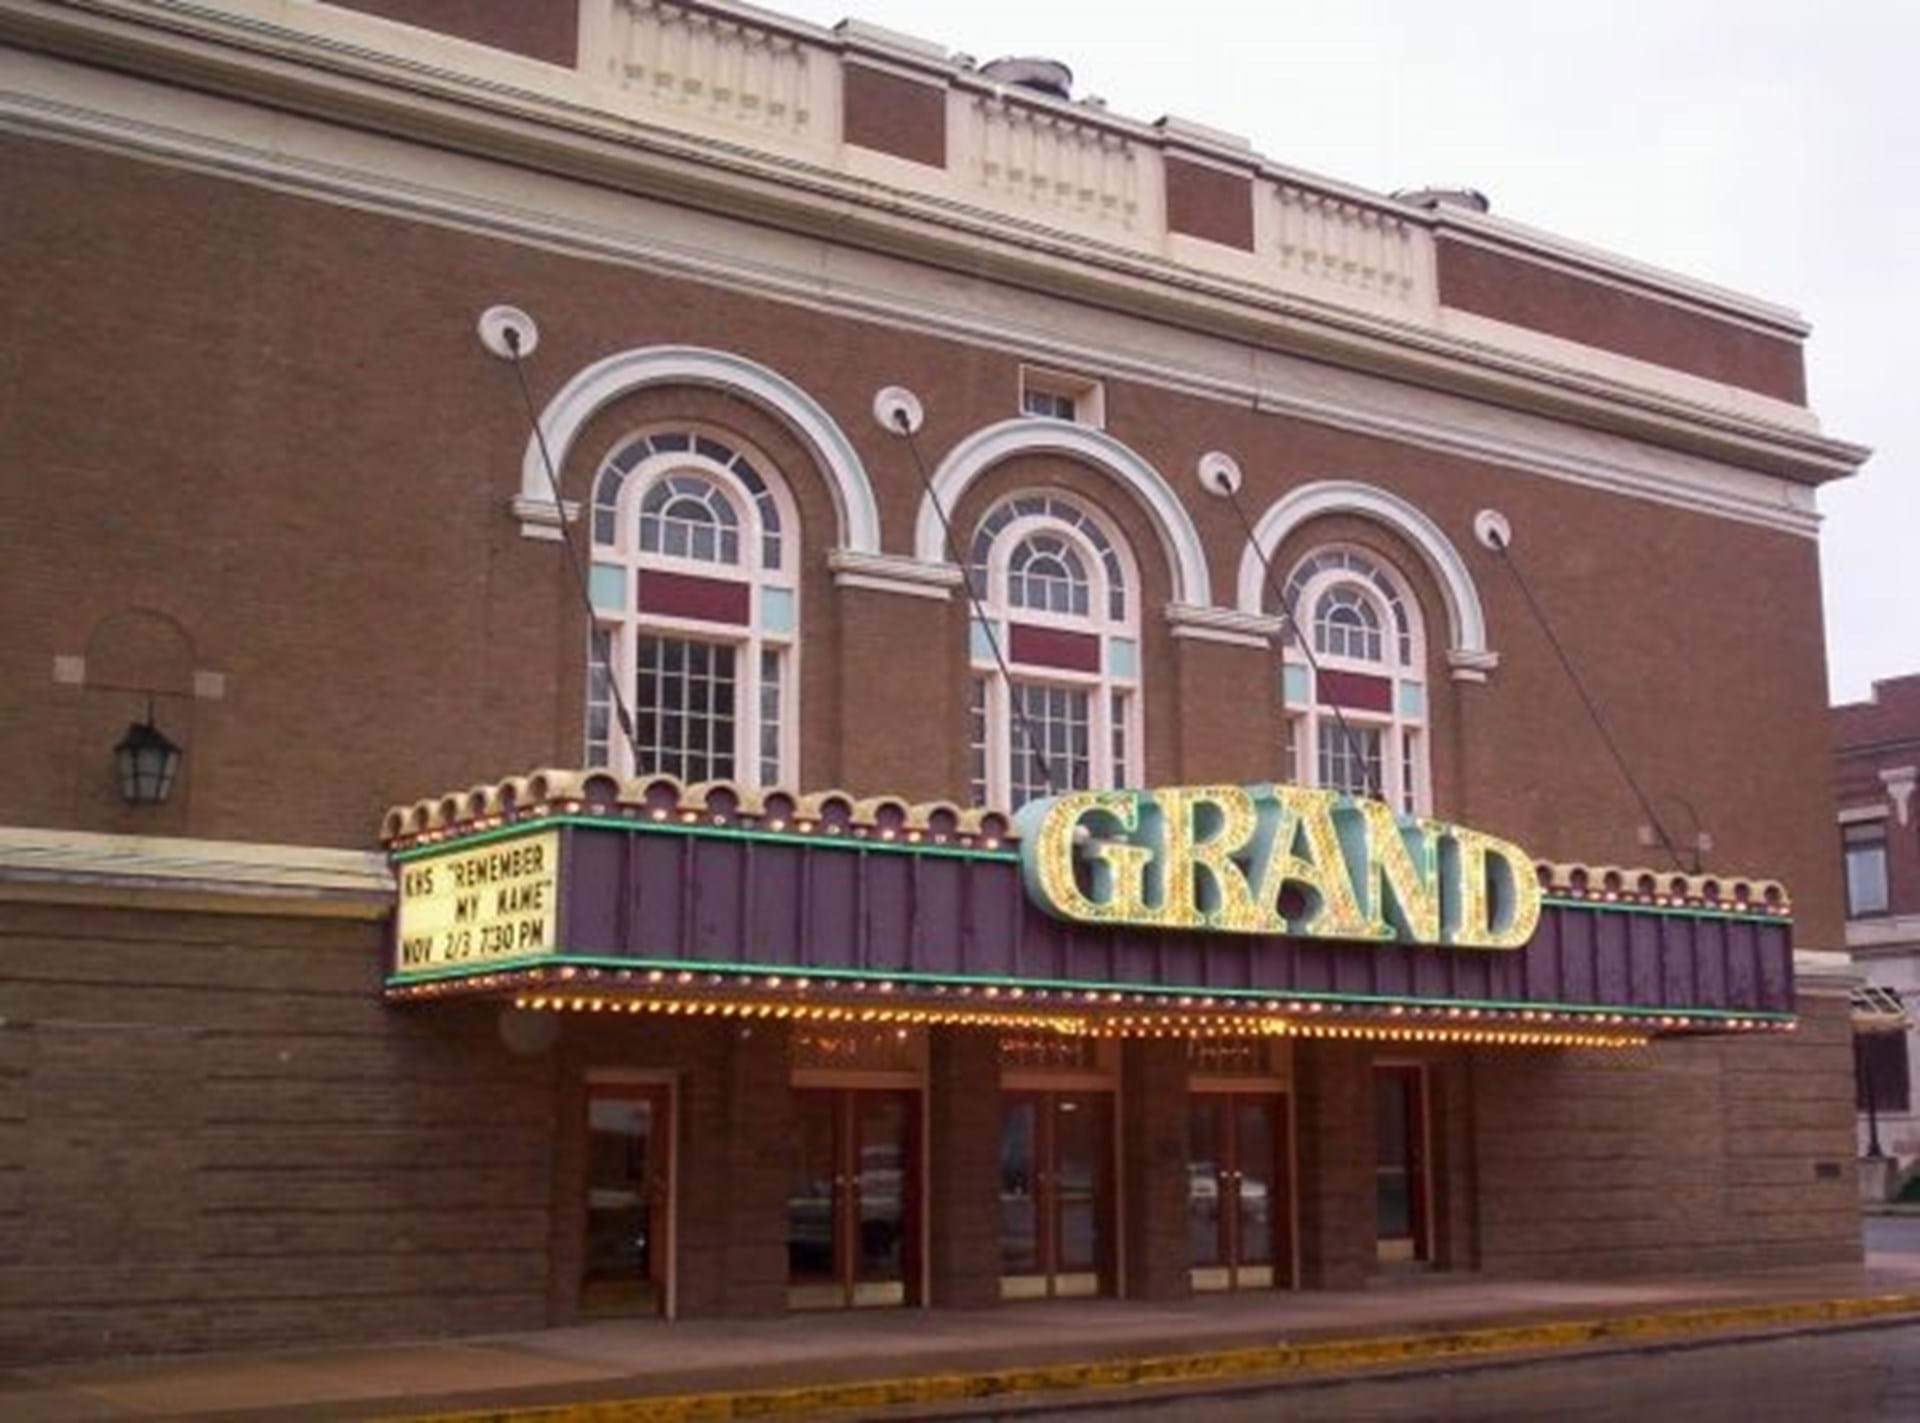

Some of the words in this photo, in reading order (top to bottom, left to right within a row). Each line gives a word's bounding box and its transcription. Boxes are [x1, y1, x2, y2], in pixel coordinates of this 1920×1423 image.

[1034, 782, 1543, 951] GRAND
[455, 897, 480, 922] MY
[403, 936, 433, 965] NOV
[444, 931, 471, 960] 2/3
[518, 918, 544, 948] PM
